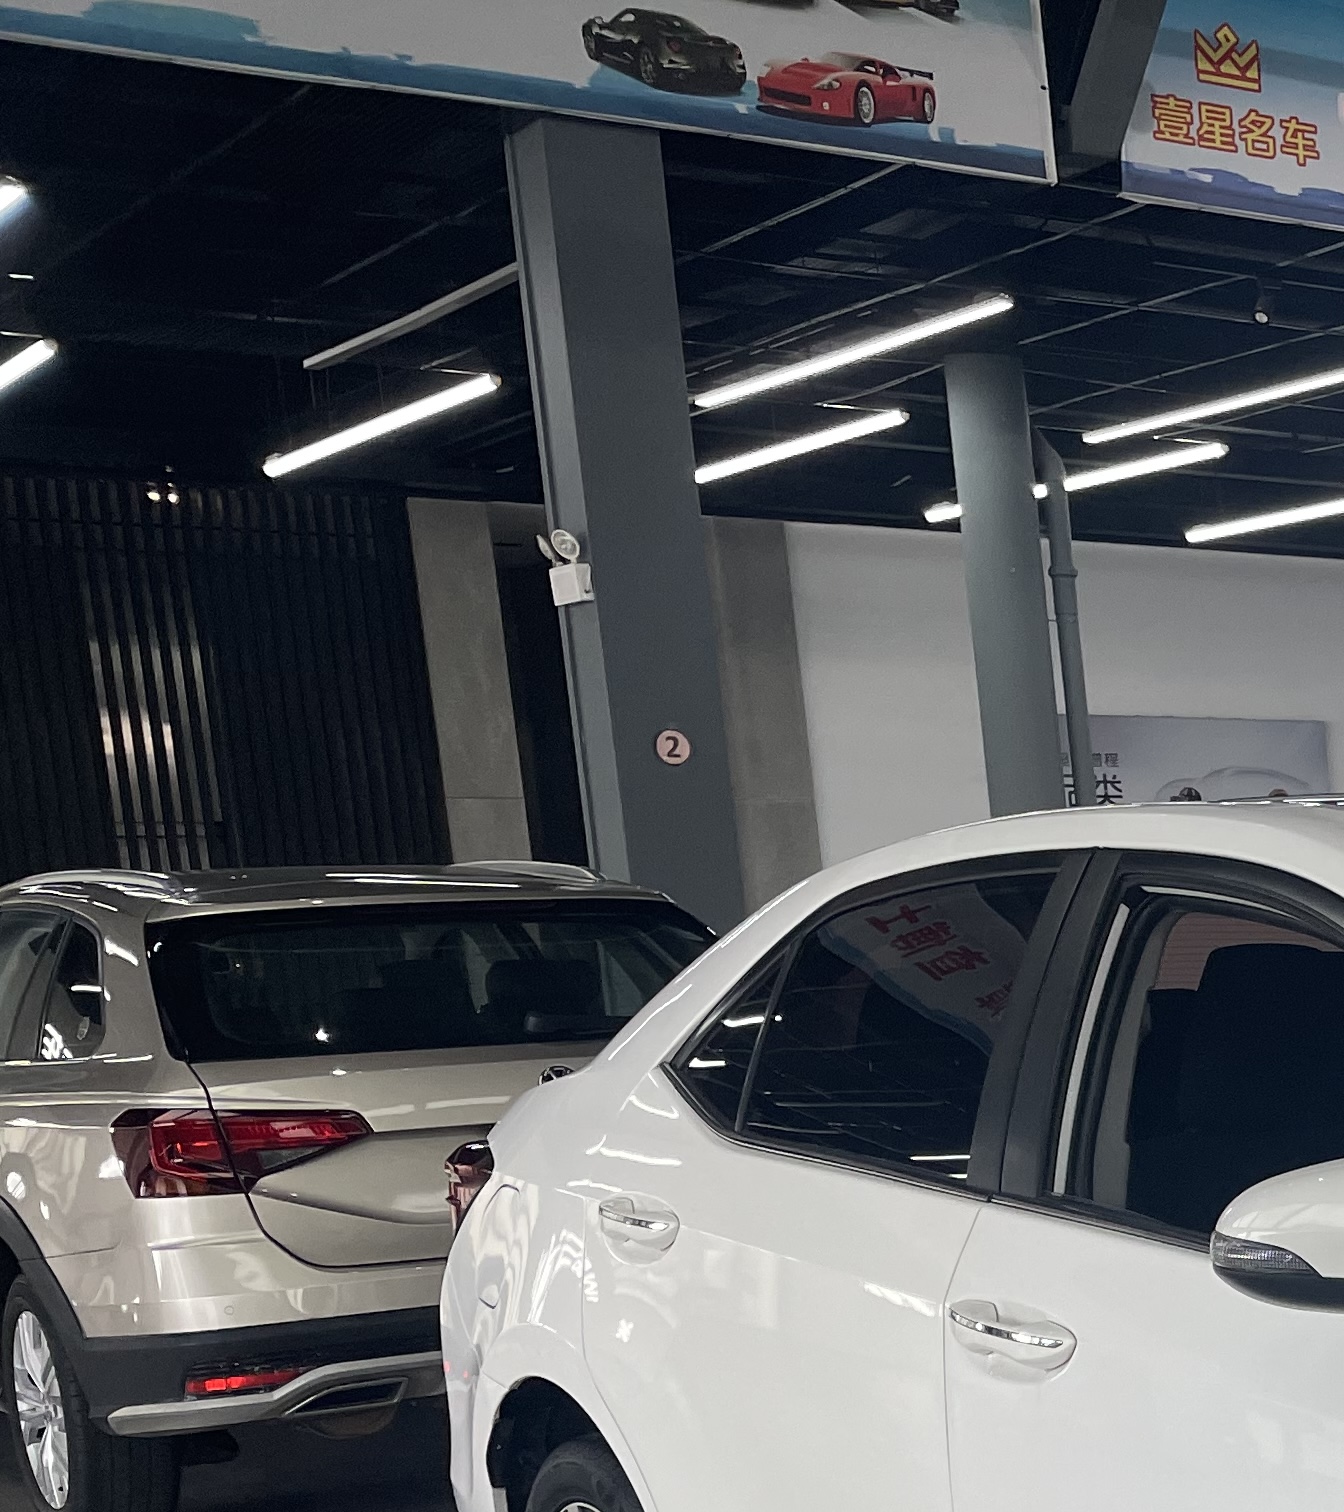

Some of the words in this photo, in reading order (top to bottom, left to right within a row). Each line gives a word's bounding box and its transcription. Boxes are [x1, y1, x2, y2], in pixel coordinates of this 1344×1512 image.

[1150, 93, 1320, 167] 壹星名车
[665, 735, 682, 758] 2
